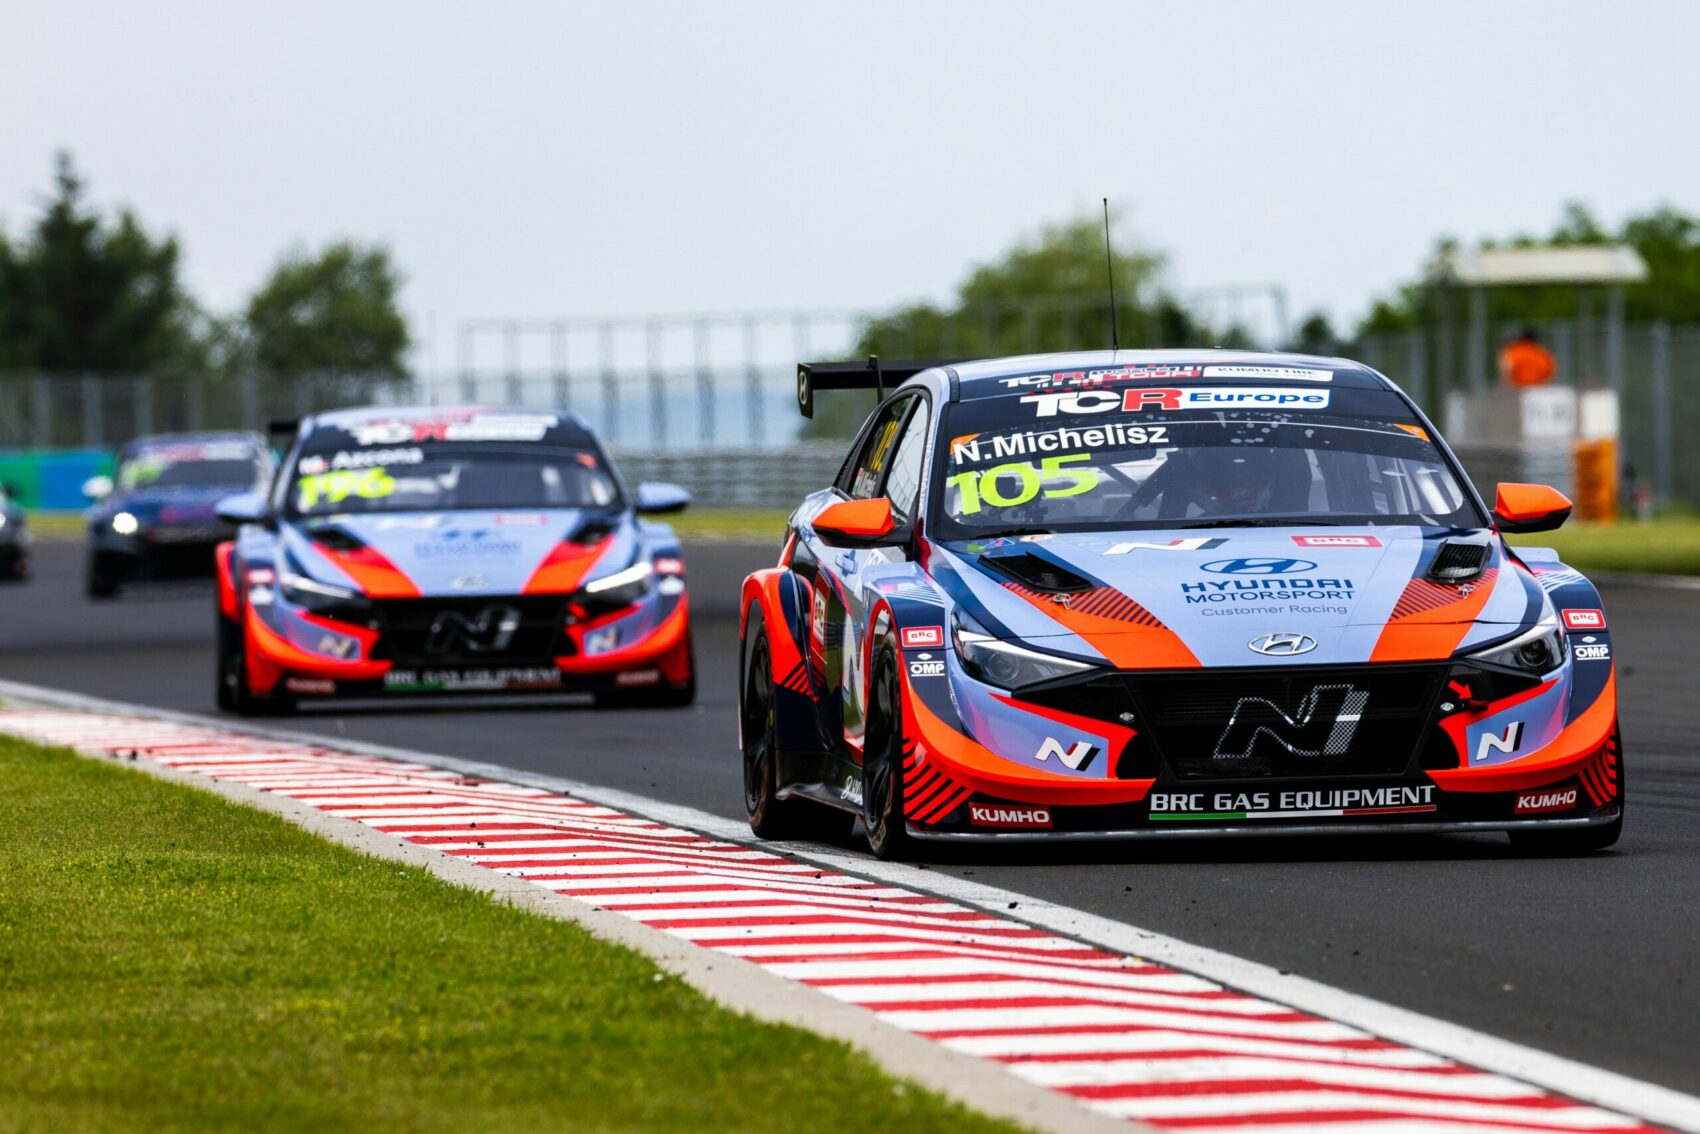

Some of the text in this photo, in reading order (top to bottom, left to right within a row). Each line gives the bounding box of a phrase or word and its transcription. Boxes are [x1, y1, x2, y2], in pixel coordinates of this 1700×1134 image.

[999, 371, 1086, 388] TCR
[1019, 387, 1325, 417] TCR Europe
[953, 423, 1170, 465] N.Michelisz
[298, 466, 396, 506] 196
[949, 452, 1100, 515] 105
[1181, 579, 1354, 593] HYUNDAI
[1186, 590, 1356, 604] MOTORSPORT
[1201, 604, 1348, 617] Customer Racing
[911, 631, 934, 639] BRC
[1574, 646, 1609, 658] OMP
[910, 663, 945, 675] OMP
[1150, 785, 1436, 811] BRC GAS EQUIPMENT
[1517, 790, 1577, 809] KUMHO
[972, 807, 1050, 823] KUMHO
